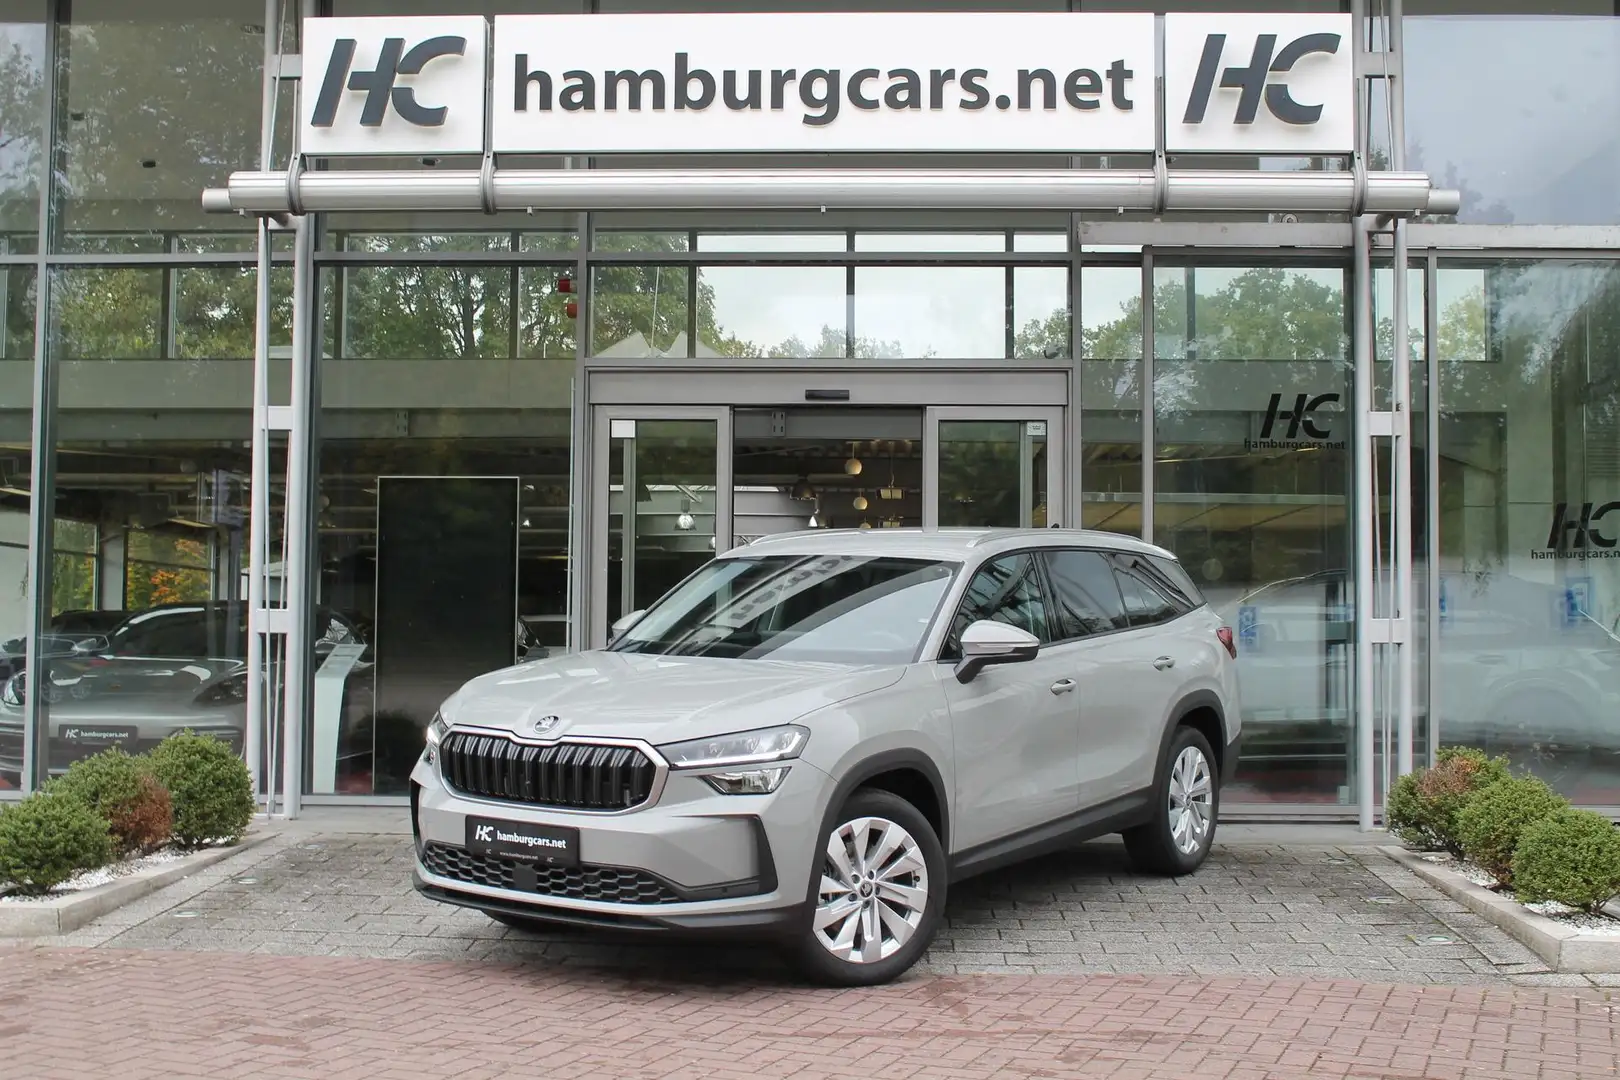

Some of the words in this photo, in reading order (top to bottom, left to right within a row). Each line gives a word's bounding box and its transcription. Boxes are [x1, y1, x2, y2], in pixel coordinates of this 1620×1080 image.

[311, 35, 467, 127] HC
[514, 52, 1133, 126] hamburgcars.net
[1182, 33, 1342, 125] HC
[1260, 393, 1340, 439] HC
[1244, 438, 1346, 452] hamburgcars.net
[80, 730, 129, 739] hamburgcars.net
[475, 825, 494, 842] HC
[497, 830, 567, 849] hamburgcars.net
